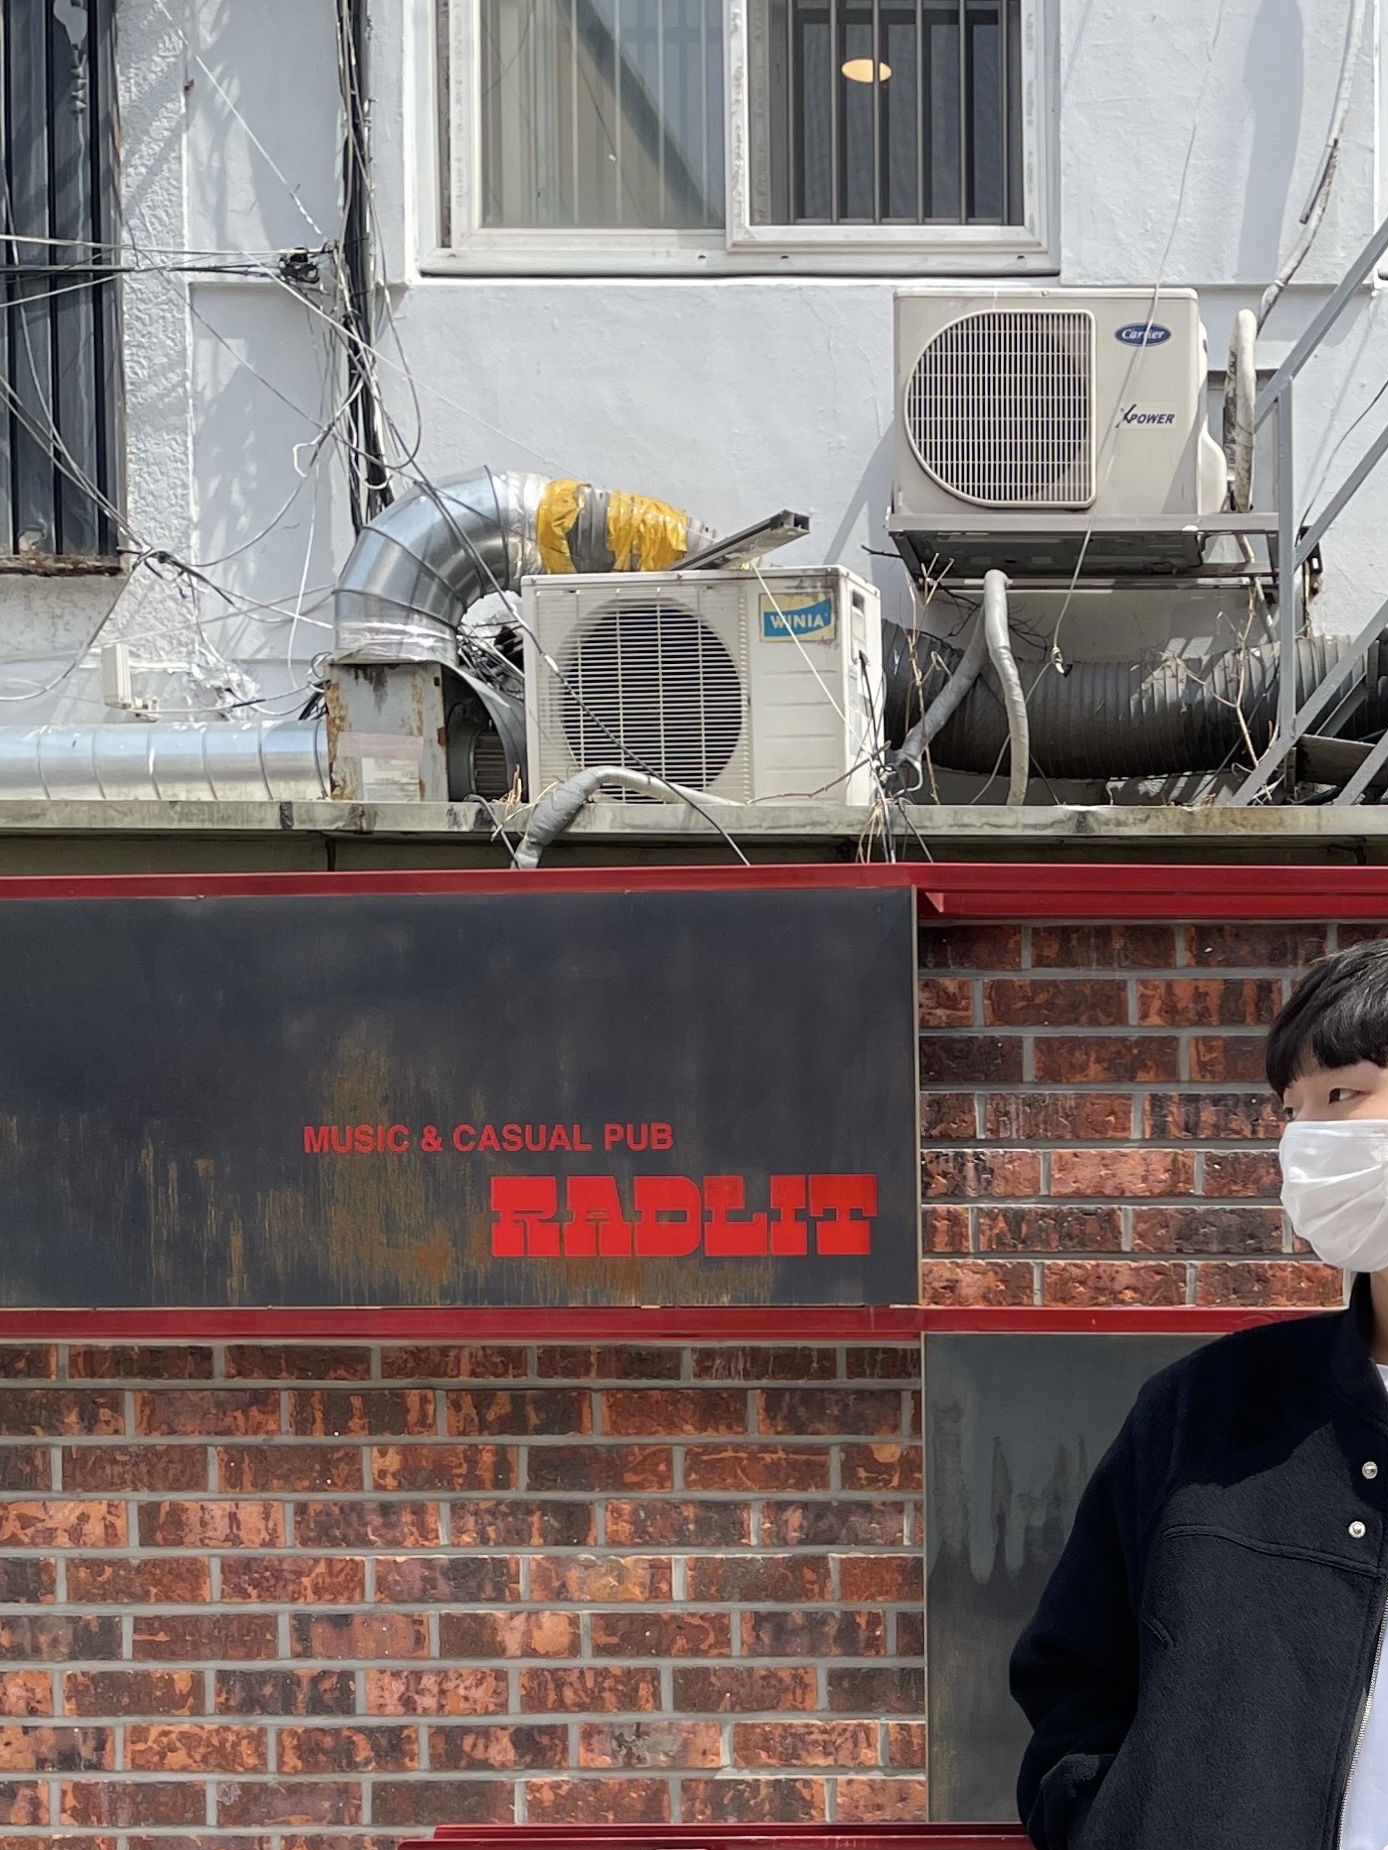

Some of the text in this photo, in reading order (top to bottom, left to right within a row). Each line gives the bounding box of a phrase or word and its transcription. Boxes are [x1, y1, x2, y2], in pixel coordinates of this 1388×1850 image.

[1121, 327, 1165, 339] Carier
[770, 613, 825, 629] WINIA
[303, 1122, 675, 1154] MUSIC & CASUAL PUB
[490, 1174, 878, 1257] RADLIT
